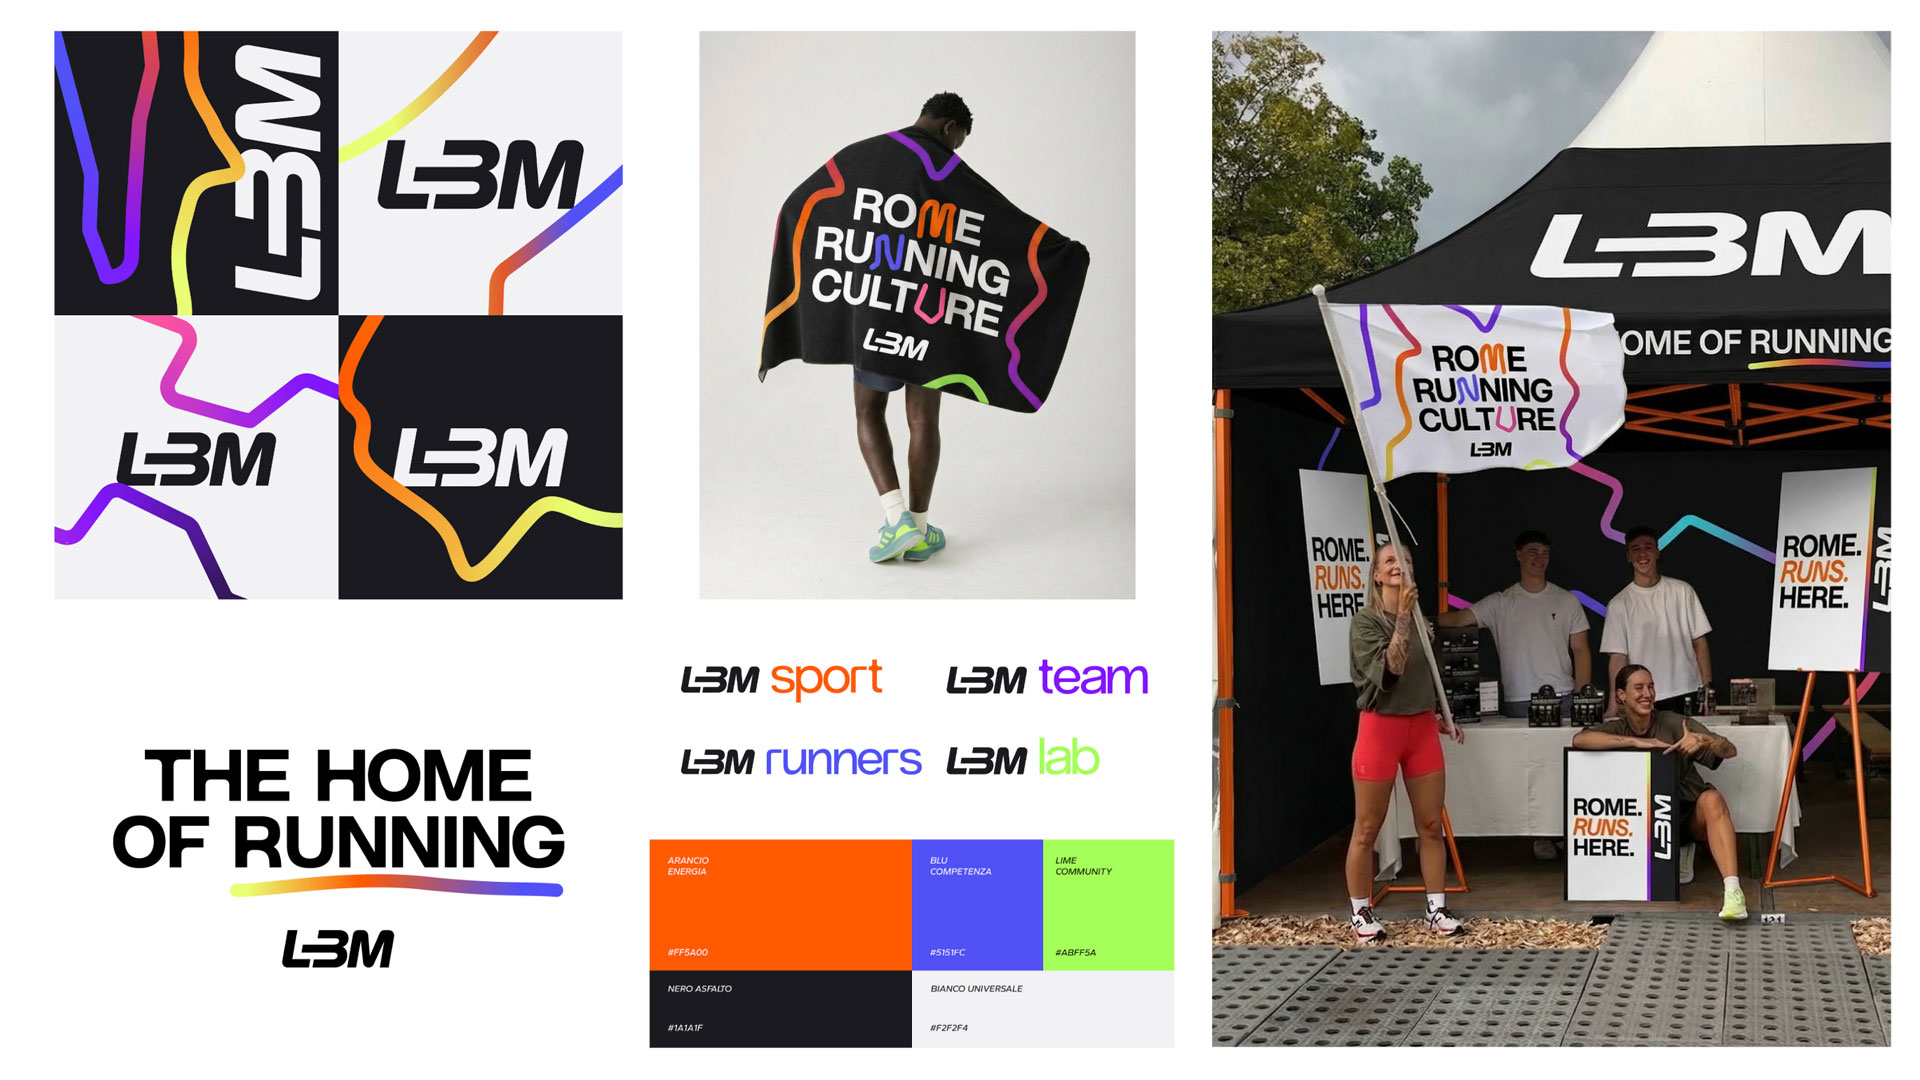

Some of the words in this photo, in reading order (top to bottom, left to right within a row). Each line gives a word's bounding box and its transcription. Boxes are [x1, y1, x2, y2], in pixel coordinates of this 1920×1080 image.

[236, 45, 321, 301] LBM
[378, 140, 584, 209] LBM
[853, 187, 985, 246] ROME
[1530, 210, 1891, 278] LBM
[814, 226, 1011, 297] RUNNING
[811, 268, 1003, 337] CULTURE
[863, 328, 929, 361] LBM
[1617, 330, 1692, 356] OME
[1700, 329, 1742, 355] OF
[1750, 327, 1891, 355] RUNNING
[1432, 343, 1527, 375] ROME
[1413, 374, 1553, 405] RUNNING
[1419, 405, 1556, 433] CULTURE
[117, 433, 276, 486] LBM
[394, 428, 568, 487] LBM
[1470, 442, 1512, 457] LBM
[1311, 536, 1370, 562] ROME.
[1783, 533, 1862, 558] ROME.
[1315, 564, 1365, 591] RUNS.
[1780, 559, 1848, 584] RUNS.
[1779, 585, 1849, 609] HERE.
[681, 666, 760, 693] LBM
[771, 659, 882, 703] sport
[946, 666, 1027, 694] LBM
[1039, 659, 1149, 694] team
[681, 749, 755, 774] LBM
[766, 748, 922, 775] runners
[946, 747, 1028, 775] LBM
[1039, 737, 1100, 775] lab
[145, 749, 290, 802] THE
[318, 748, 532, 802] HOME
[1573, 798, 1643, 817] ROME.
[1573, 818, 1633, 837] RUNS.
[1654, 794, 1672, 860] LBM
[113, 815, 209, 868] OF
[235, 815, 565, 868] RUNNING
[1573, 839, 1634, 857] HERE.
[667, 856, 710, 865] ARANCIO
[667, 867, 707, 876] ENERGIA
[930, 856, 949, 865] BLU
[930, 867, 992, 876] COMPETENZA
[1055, 856, 1078, 865] LIME
[1055, 867, 1113, 876] COMMUNITY
[282, 930, 395, 968] LBM
[667, 948, 709, 957] #FF5A00
[930, 948, 966, 957] #5151FC
[1055, 948, 1097, 957] #ABFF5A
[667, 984, 693, 993] NERO
[695, 984, 733, 993] ASFALTO
[930, 984, 966, 993] BIANCO
[967, 984, 1024, 993] UNIVERSALE
[667, 1023, 704, 1032] #1A1A1F
[930, 1023, 969, 1032] #F2F2F4
